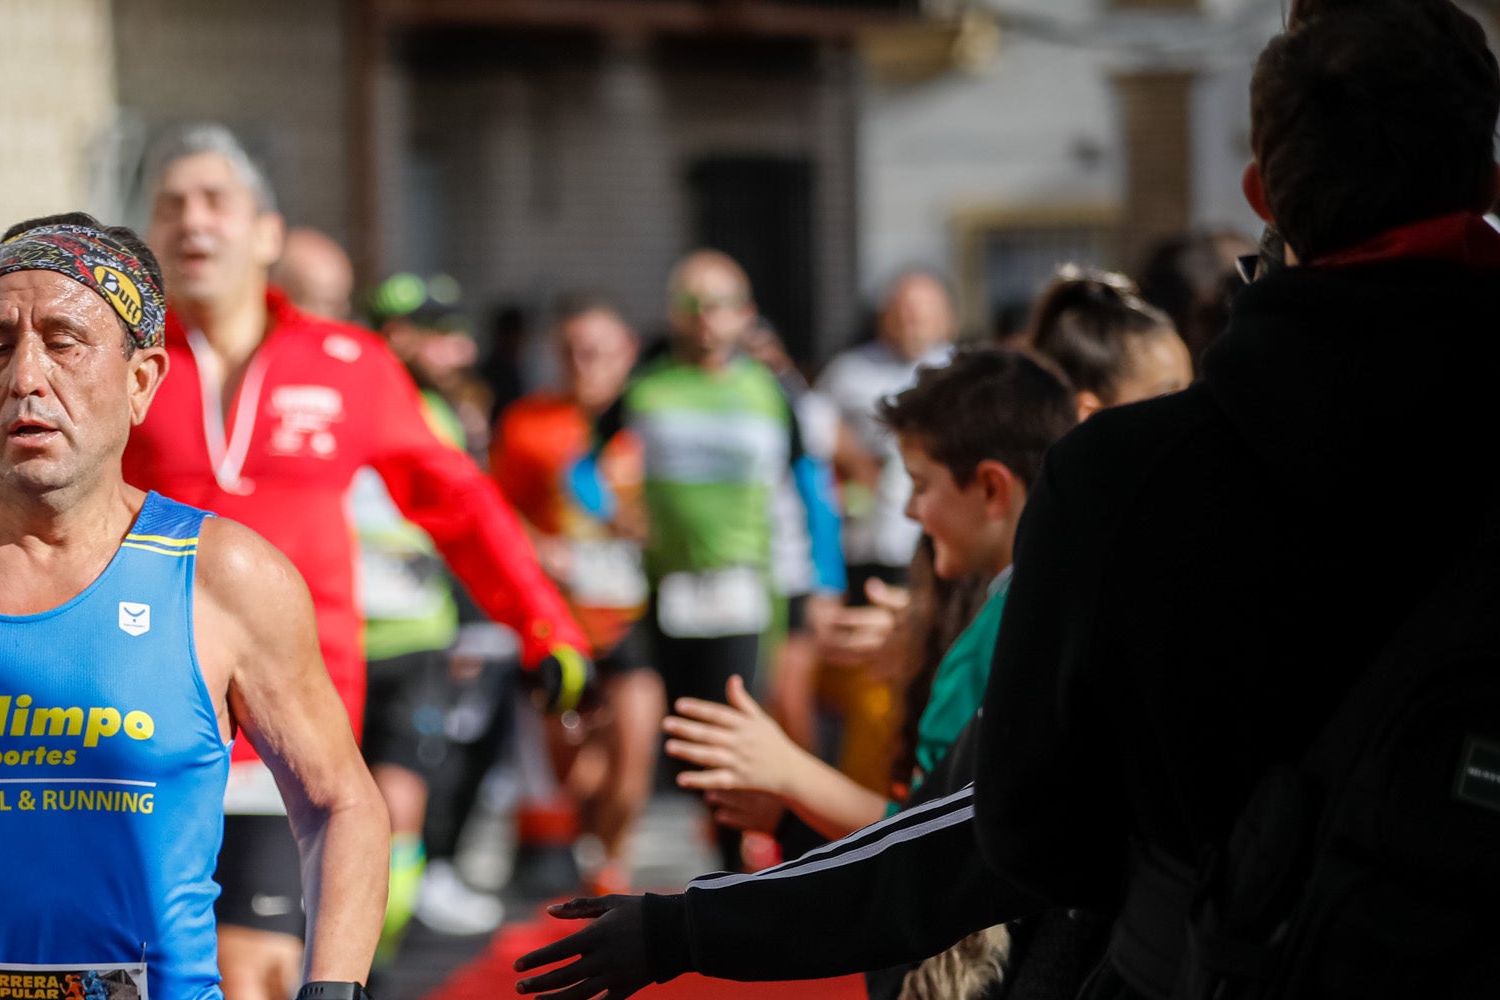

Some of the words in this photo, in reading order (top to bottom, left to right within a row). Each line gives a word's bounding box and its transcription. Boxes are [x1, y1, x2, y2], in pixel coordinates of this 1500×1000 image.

[102, 270, 142, 320] Buff
[17, 789, 36, 812] &
[43, 790, 155, 815] RUNNING
